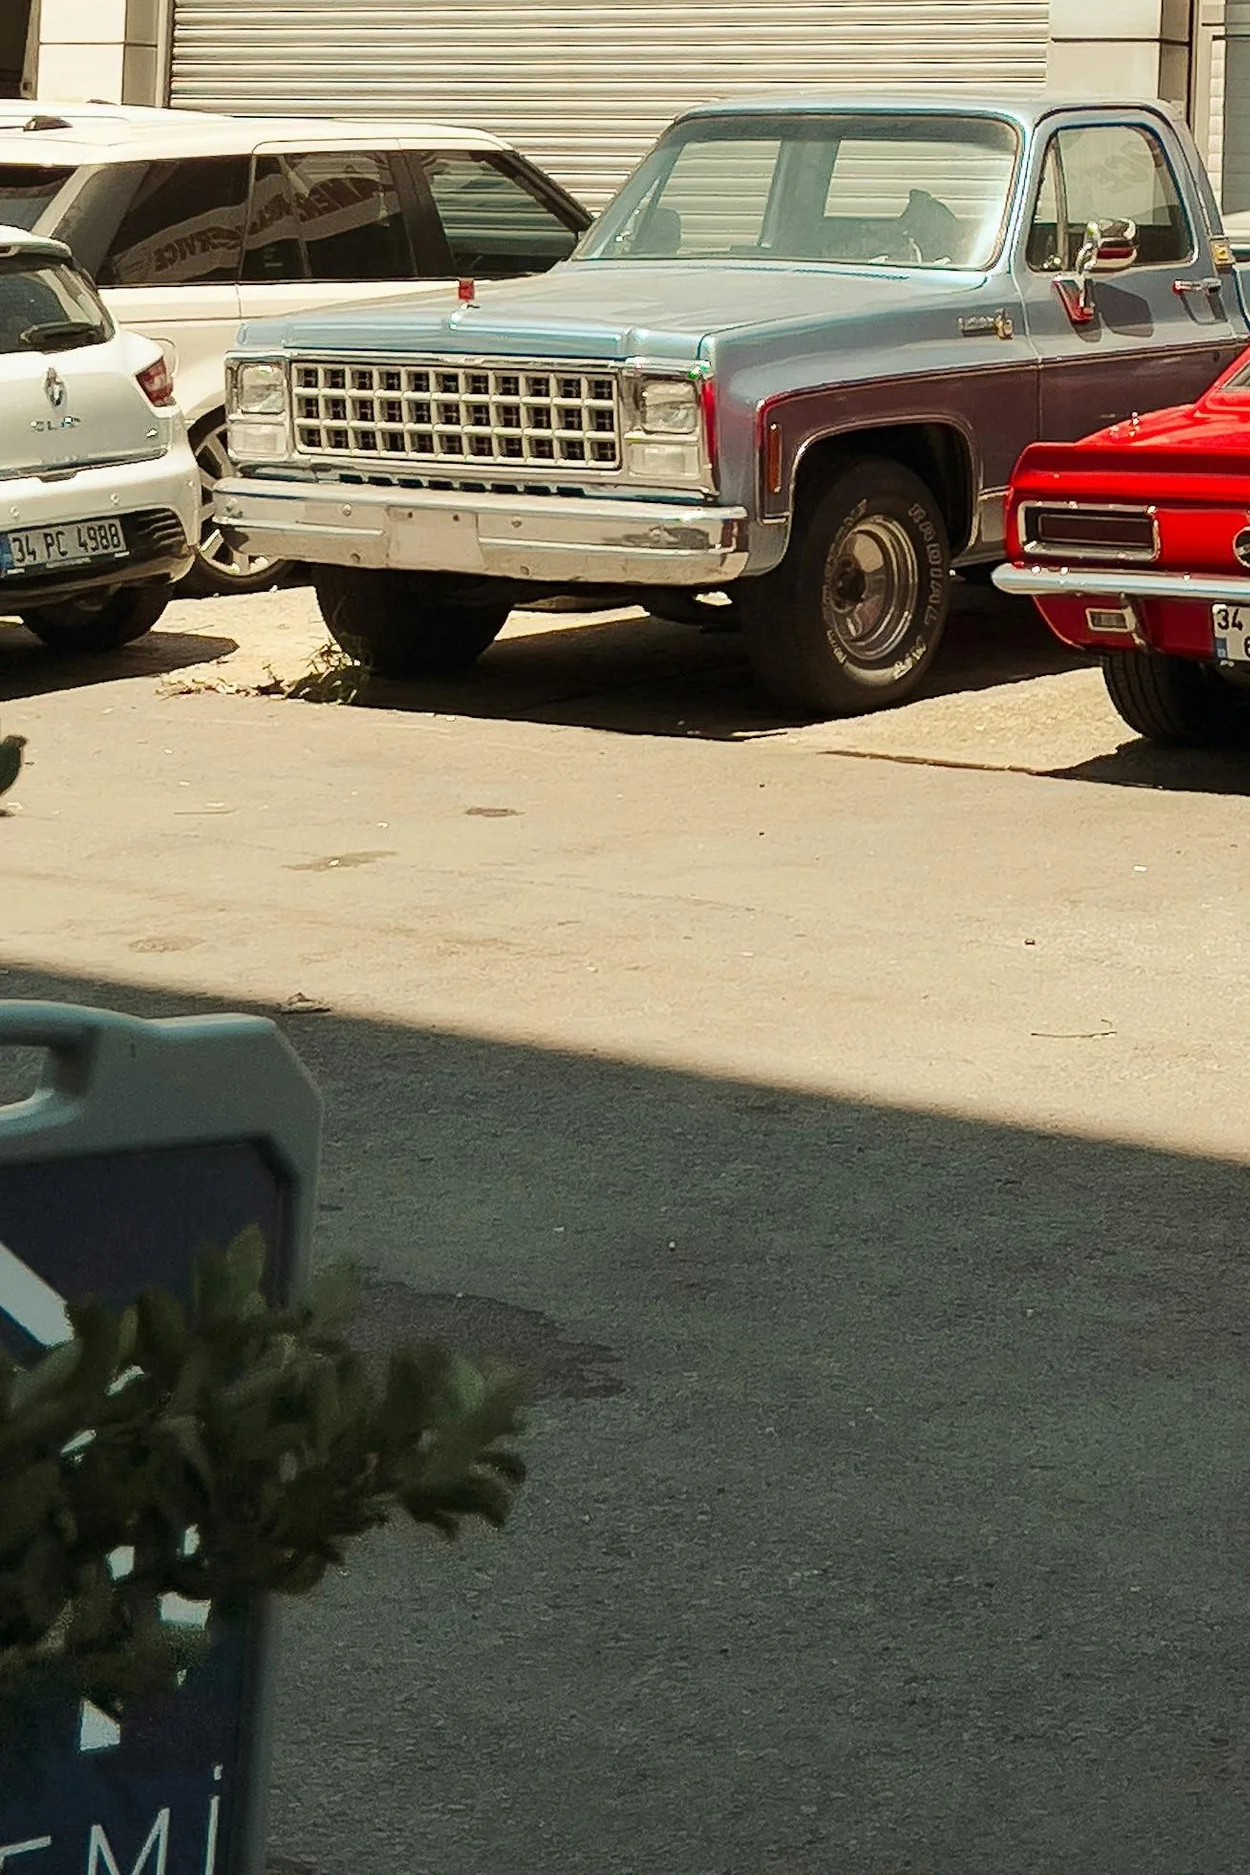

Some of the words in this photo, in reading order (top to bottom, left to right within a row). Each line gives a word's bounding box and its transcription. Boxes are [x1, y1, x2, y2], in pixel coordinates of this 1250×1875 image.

[12, 535, 37, 563] 34
[43, 530, 68, 558] PC
[77, 523, 121, 553] 4988
[1217, 607, 1244, 631] 34
